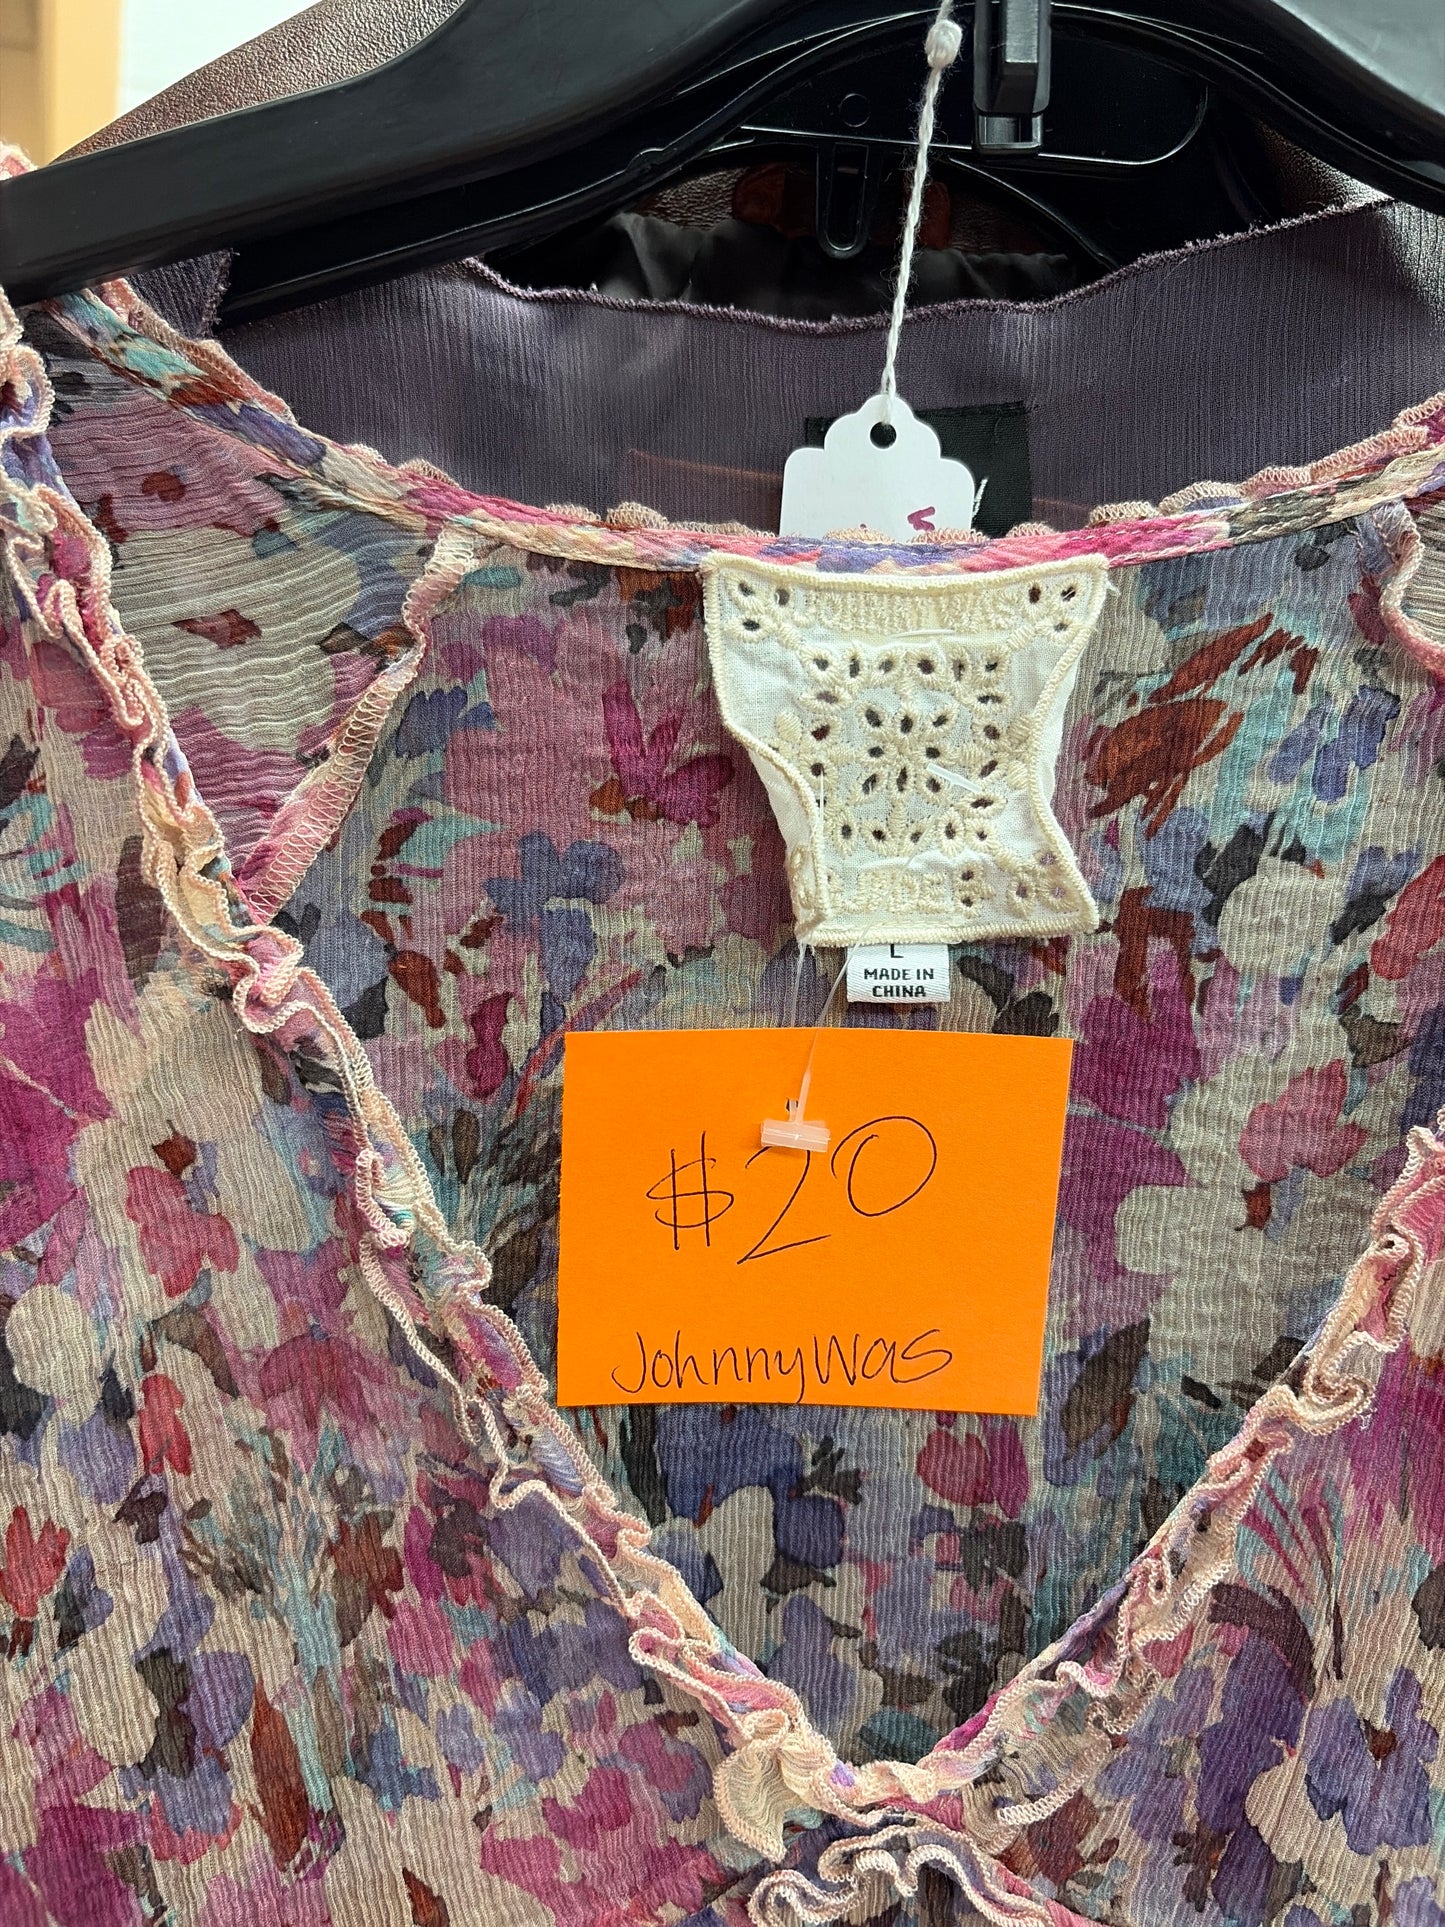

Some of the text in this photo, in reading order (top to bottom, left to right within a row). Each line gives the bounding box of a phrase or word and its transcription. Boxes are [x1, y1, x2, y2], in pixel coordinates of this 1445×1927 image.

[889, 943, 904, 958] L
[863, 968, 935, 981] MADE IN
[871, 985, 927, 998] CHINA
[645, 1115, 938, 1265] $20
